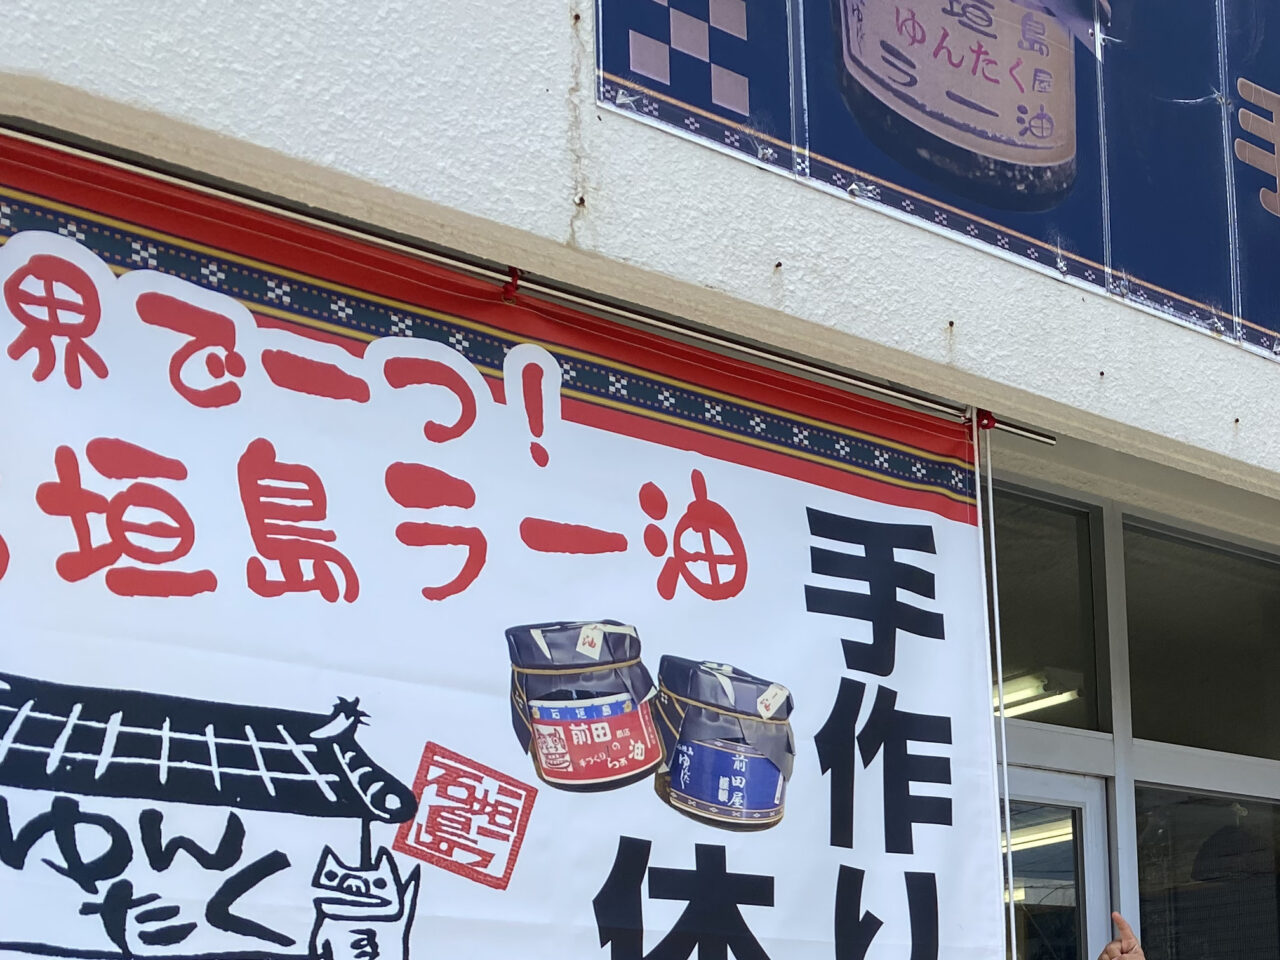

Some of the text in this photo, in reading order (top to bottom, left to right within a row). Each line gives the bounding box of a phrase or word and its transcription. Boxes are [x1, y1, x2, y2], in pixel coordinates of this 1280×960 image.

[0, 437, 748, 603] 垣島ラー油
[728, 753, 749, 809] 前田屋
